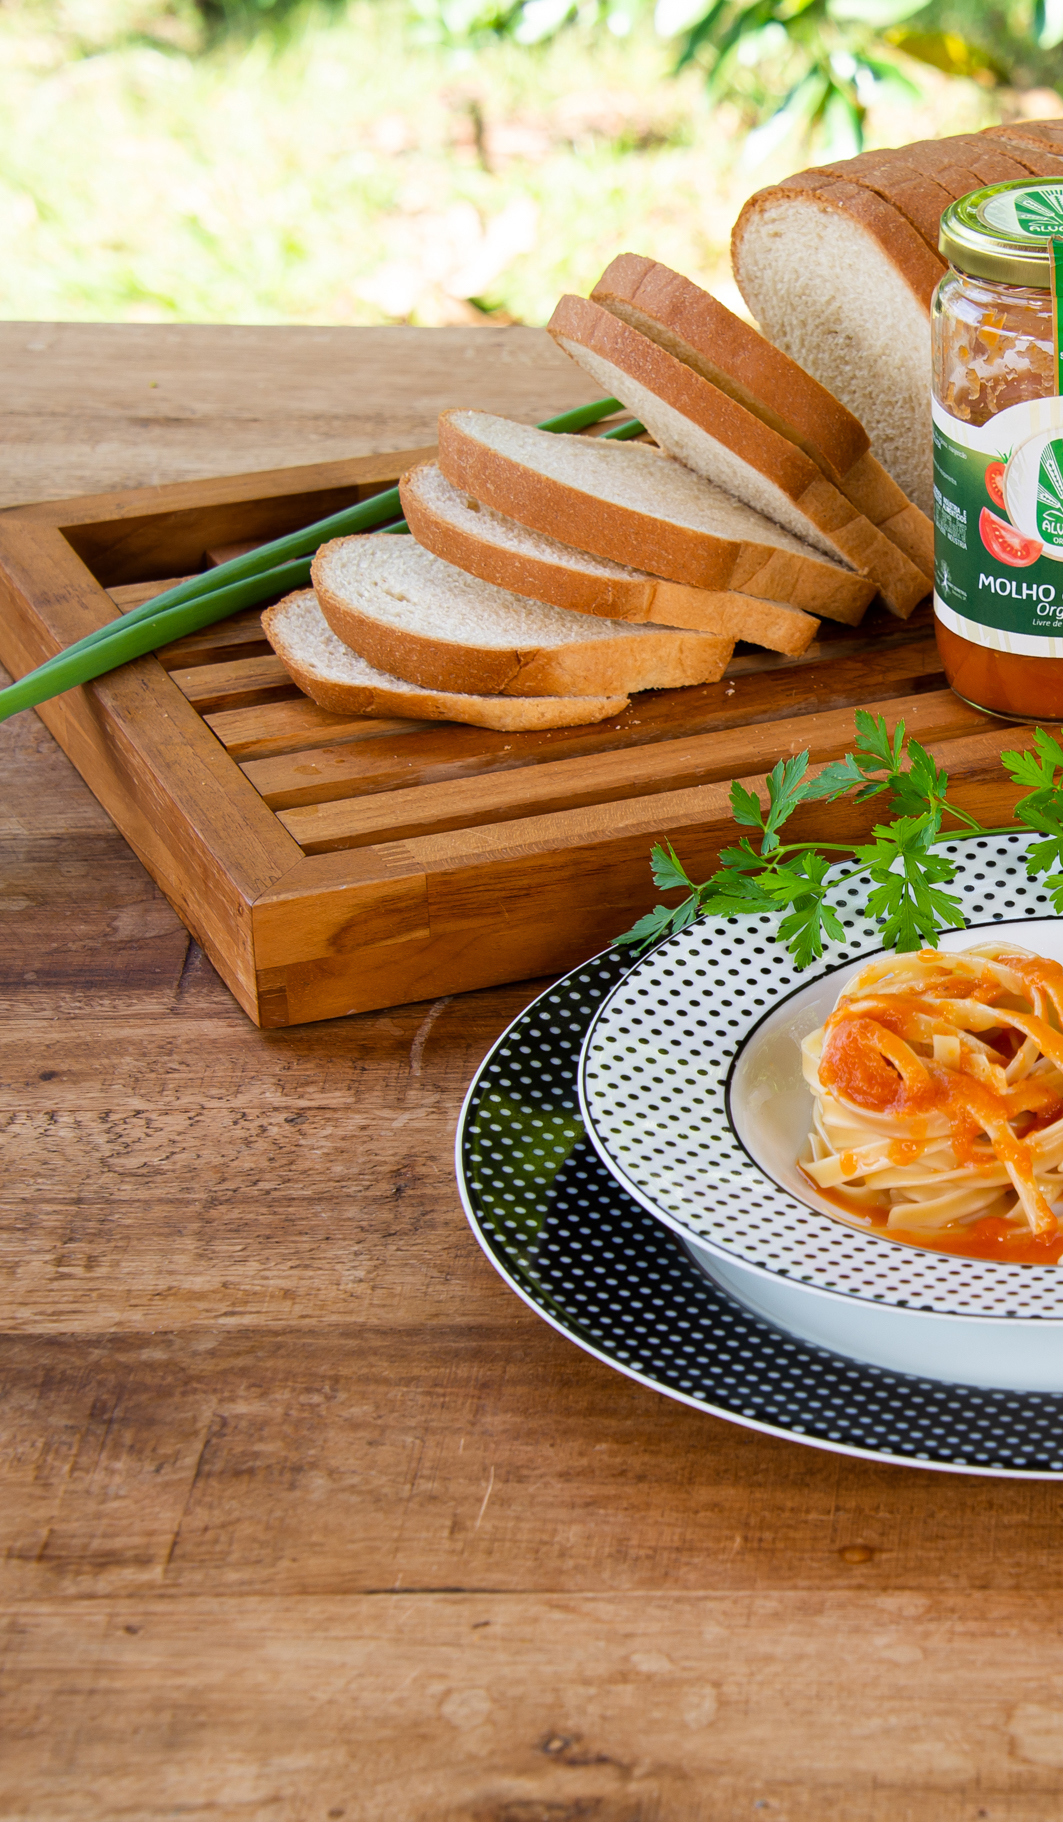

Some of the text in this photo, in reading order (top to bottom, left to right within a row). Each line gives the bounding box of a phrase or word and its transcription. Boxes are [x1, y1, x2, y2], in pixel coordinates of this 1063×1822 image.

[978, 572, 1056, 602] MOLHO
[1032, 618, 1051, 626] Livre
[1052, 619, 1063, 628] de
